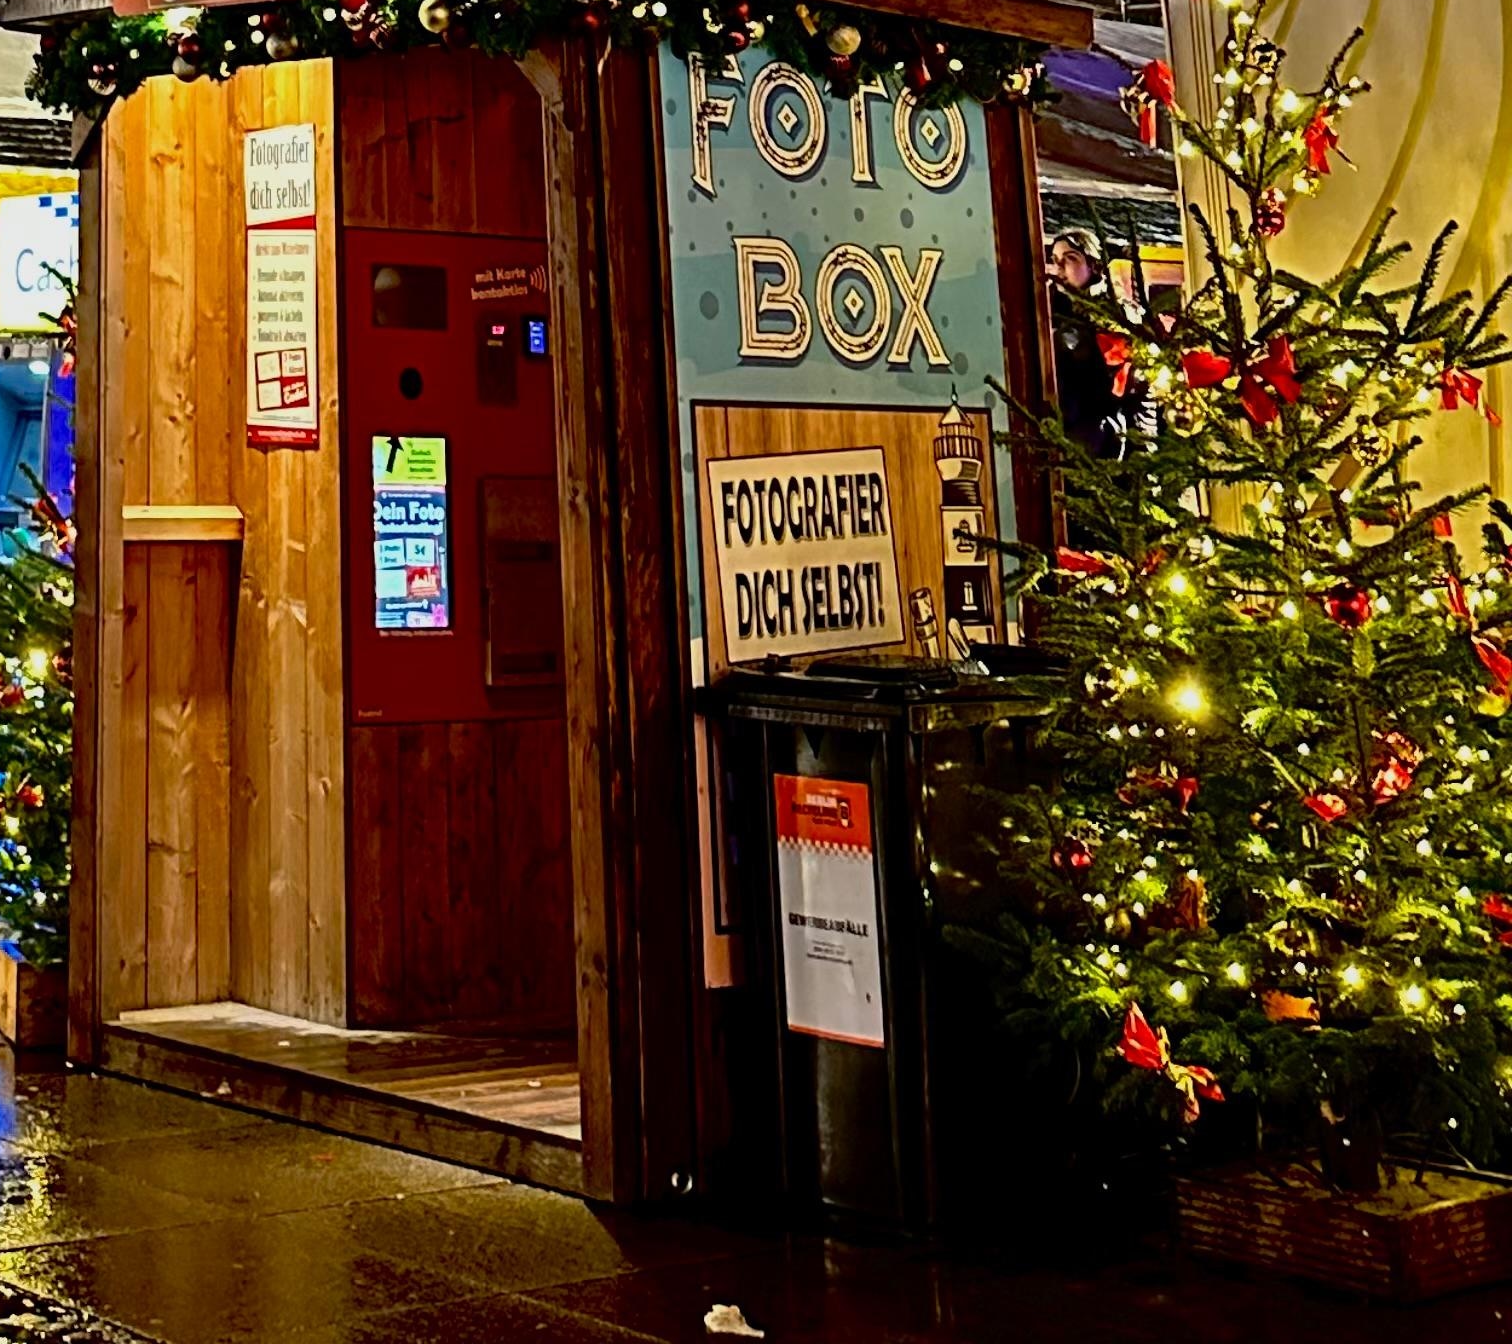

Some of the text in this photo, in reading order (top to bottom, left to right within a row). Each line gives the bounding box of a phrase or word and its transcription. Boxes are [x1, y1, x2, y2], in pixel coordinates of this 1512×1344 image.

[250, 135, 310, 169] Fotografier
[250, 179, 311, 210] dich selbst!
[732, 235, 952, 365] BOX
[408, 500, 445, 521] Foto
[721, 472, 888, 548] FOTOGRAFIER
[735, 561, 886, 639] DICH SELBST!
